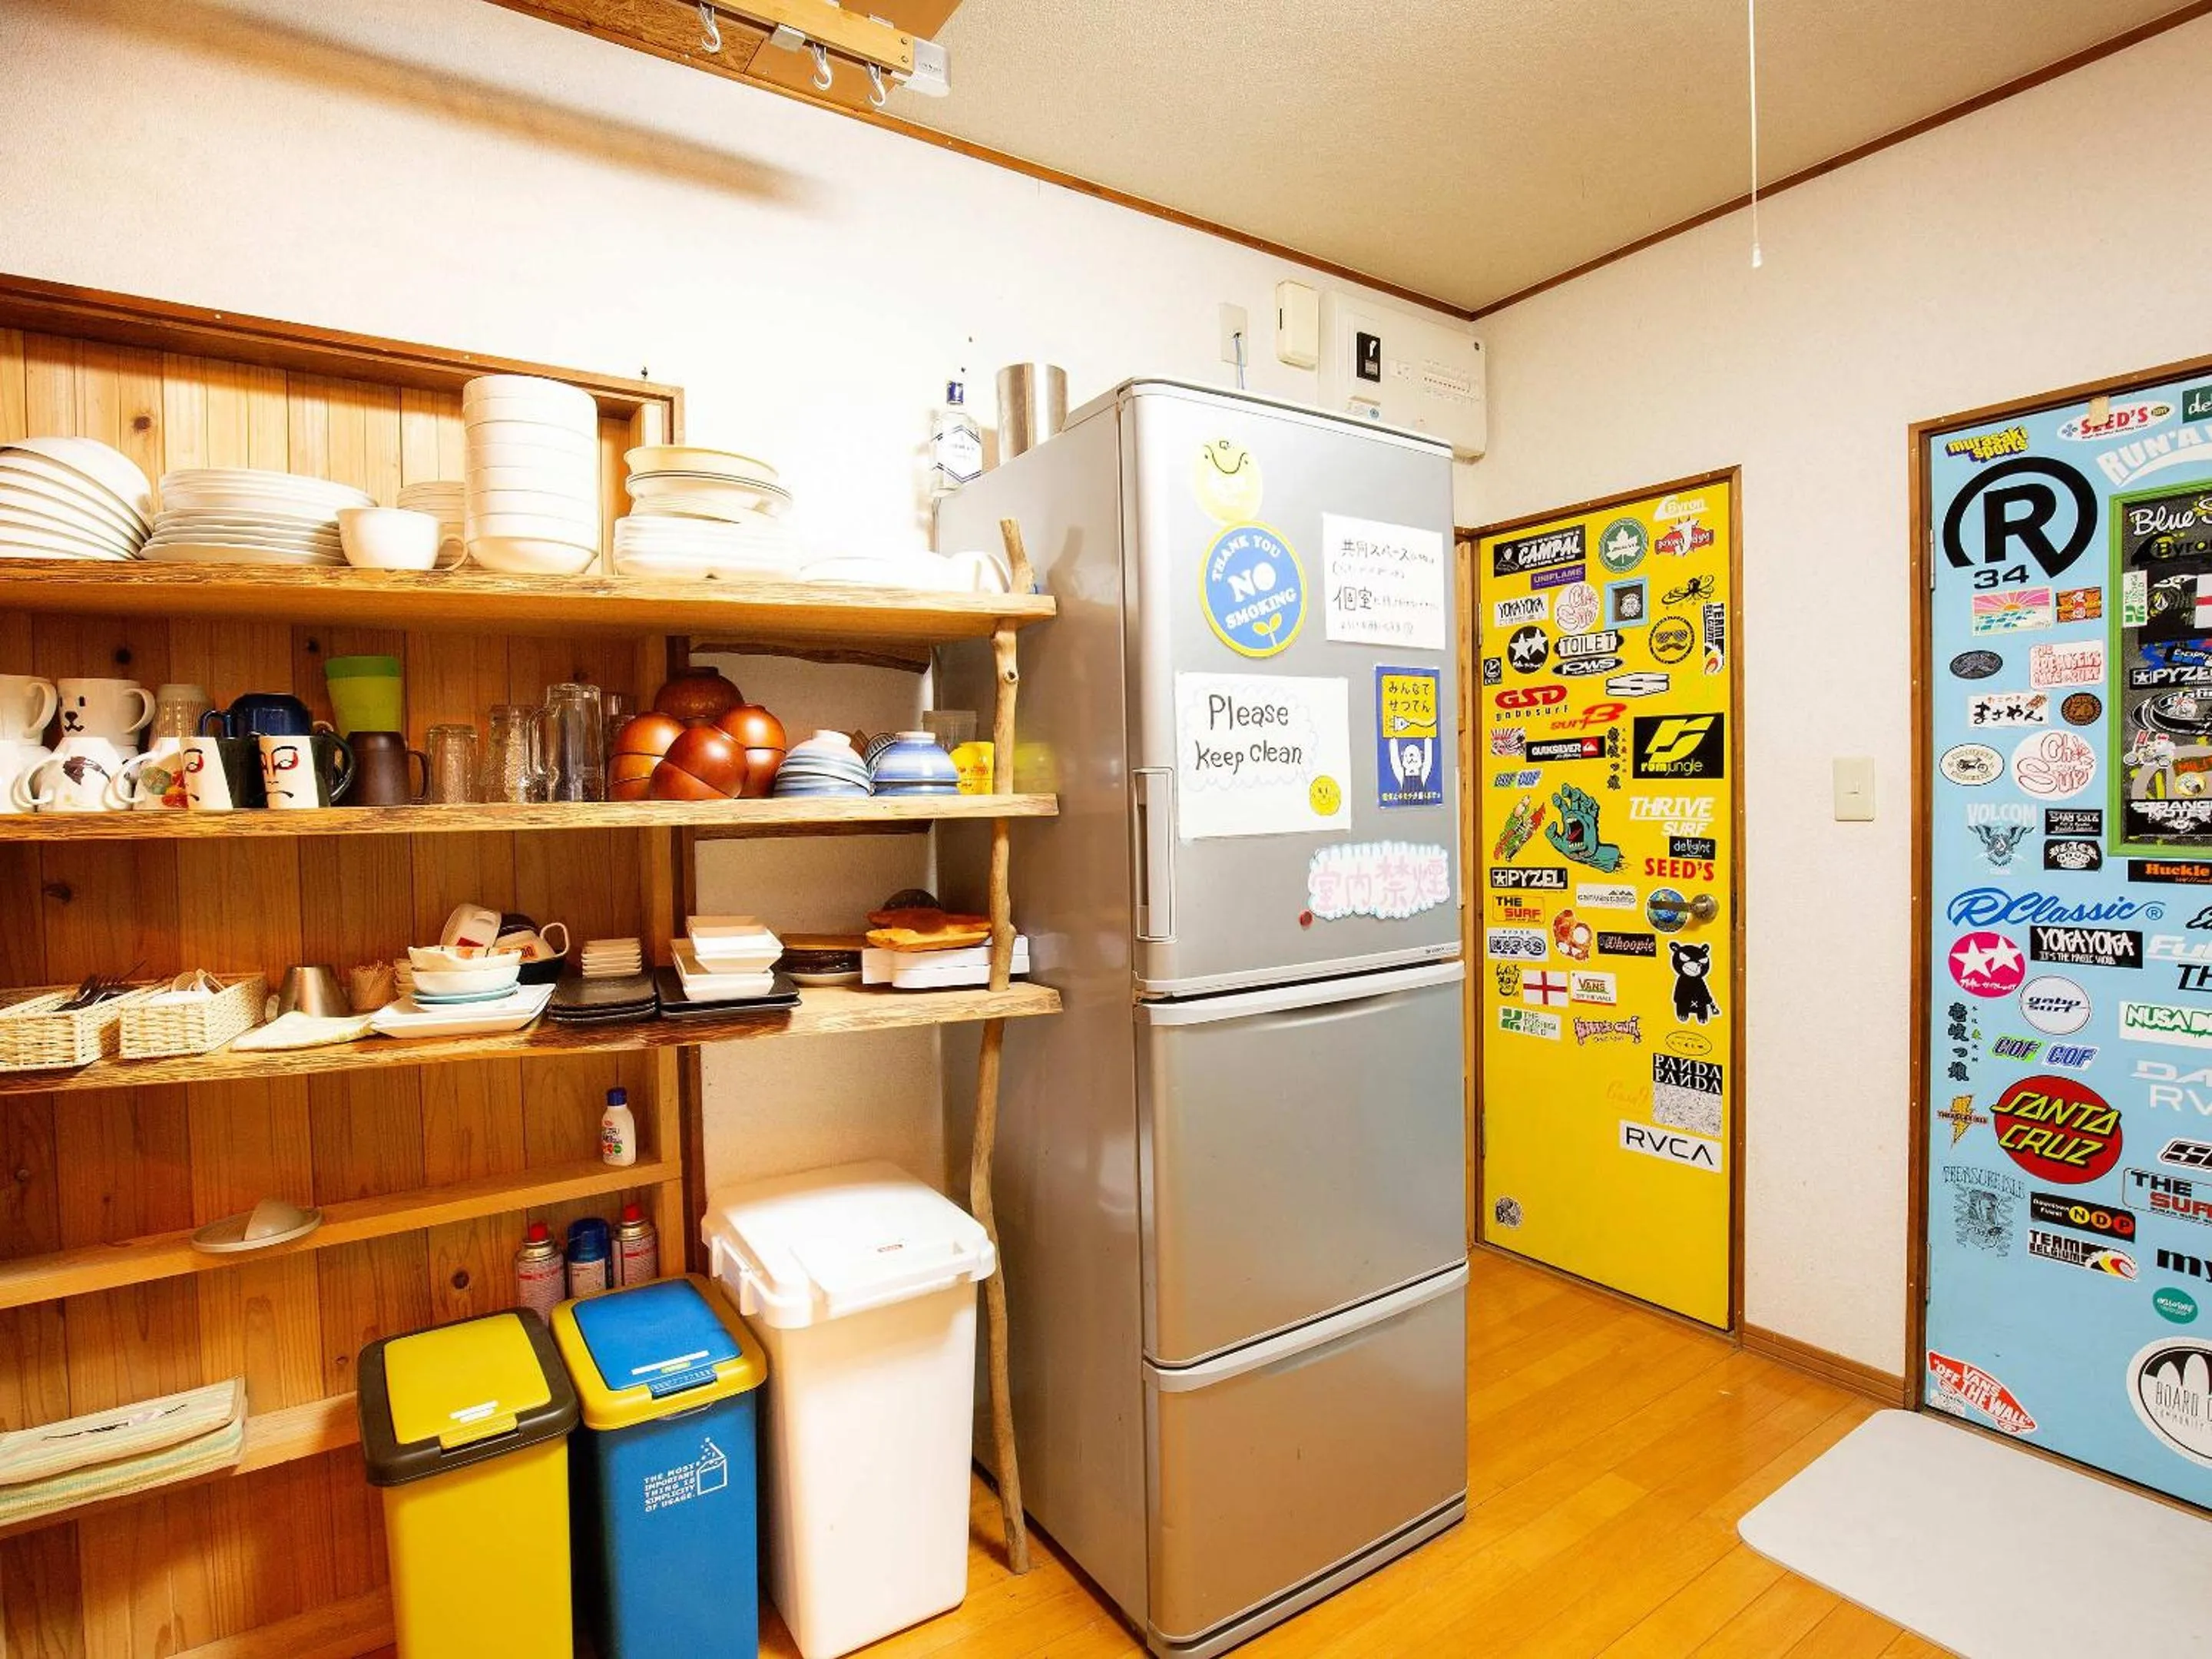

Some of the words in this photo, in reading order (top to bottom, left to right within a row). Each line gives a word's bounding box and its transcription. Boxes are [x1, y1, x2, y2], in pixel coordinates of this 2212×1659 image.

[1947, 426, 2028, 452] murasaki
[1972, 439, 2028, 460] sports
[2129, 505, 2196, 535] Blue
[1212, 535, 1250, 581] THANK
[1253, 535, 1281, 558] YOU
[1227, 561, 1277, 602] NO
[1533, 567, 1583, 584] UNIFLAME
[1974, 564, 2030, 590] 34
[1225, 588, 1296, 629] SMOKING
[1562, 633, 1614, 654] TOILET
[1495, 684, 1568, 710] GSD
[1208, 694, 1290, 731] Please
[1194, 740, 1244, 775] keep
[1531, 743, 1581, 757] QUIKSILVER
[1629, 796, 1715, 820] THRIVE
[1967, 803, 2037, 826] VOLCOM
[1661, 821, 1707, 837] SURF
[1508, 869, 1565, 887] PYZEL
[1645, 857, 1714, 882] SEED'S
[1313, 855, 1445, 911] 室内禁煙
[1495, 896, 1522, 907] THE
[1505, 908, 1541, 919] SURF
[2036, 926, 2135, 957] YOKAYOKA
[1578, 978, 1607, 992] VANS
[1990, 1090, 2122, 1136] SANTA
[1626, 1126, 1714, 1166] RVCA
[1998, 1123, 2106, 1167] CRUZ
[2131, 1170, 2193, 1197] THE
[2029, 1229, 2081, 1253] TEAM
[2155, 1380, 2200, 1418] BOARD
[644, 1472, 664, 1484] THE
[667, 1462, 695, 1476] MOST
[644, 1470, 695, 1492] IMPORTANT
[644, 1483, 680, 1498] THING
[644, 1504, 658, 1513] OF
